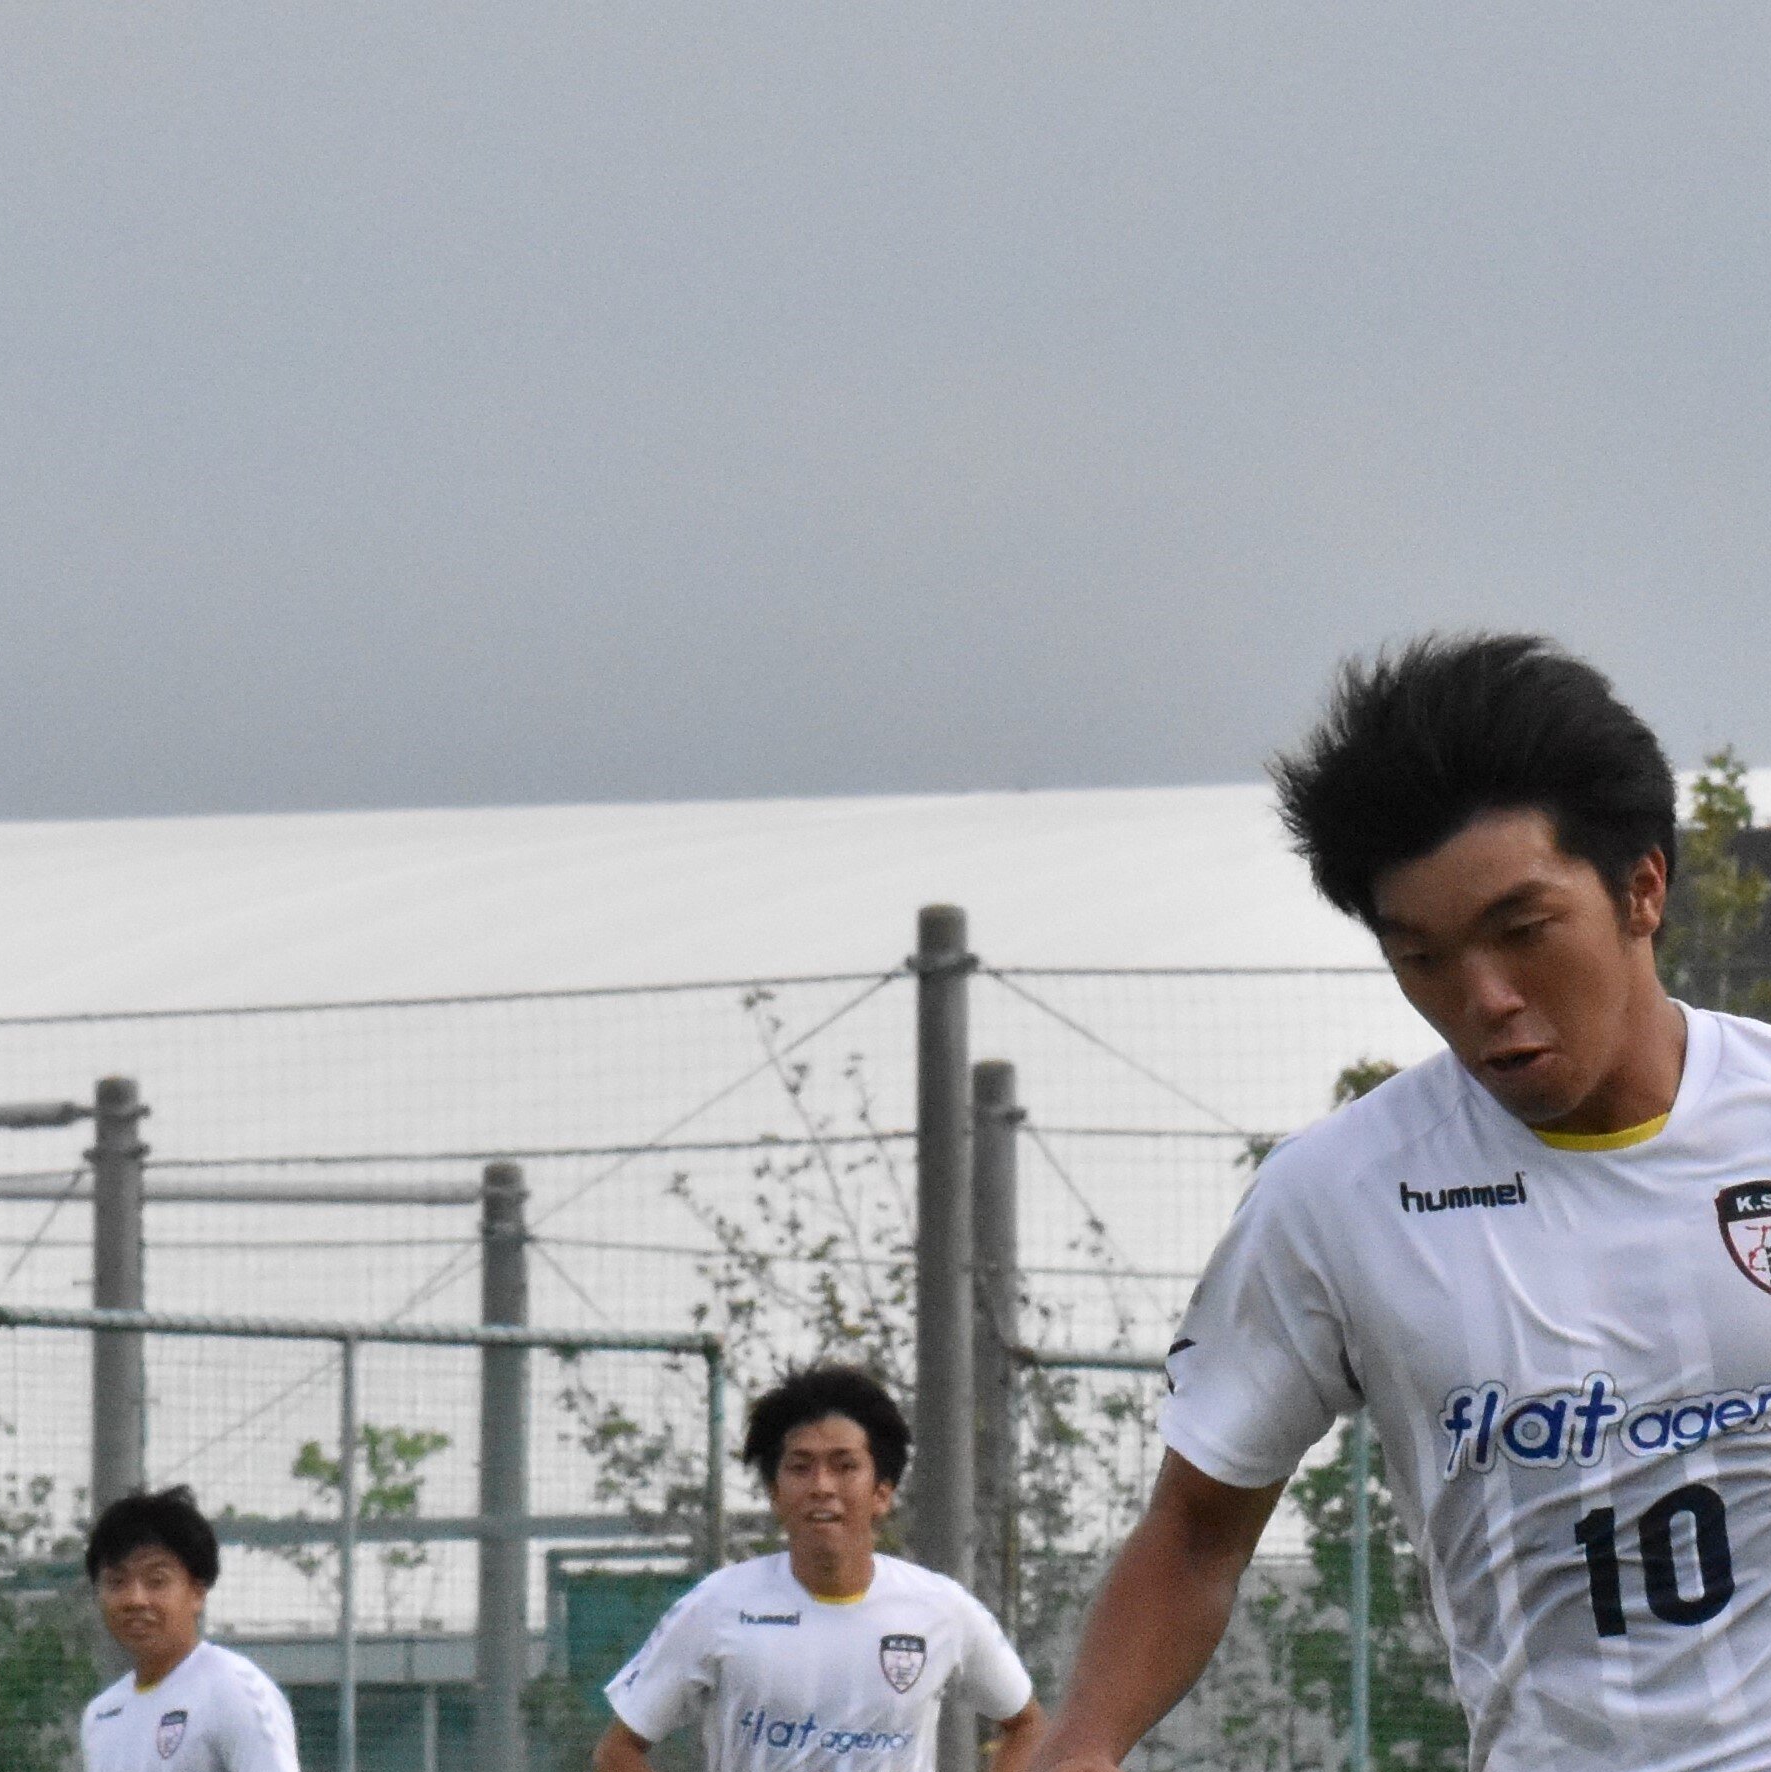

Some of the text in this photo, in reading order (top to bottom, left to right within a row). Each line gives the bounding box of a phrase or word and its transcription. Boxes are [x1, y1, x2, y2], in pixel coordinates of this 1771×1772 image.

[1400, 1171, 1526, 1213] hummel
[1445, 1381, 1617, 1472] flat
[1574, 1483, 1736, 1638] 10
